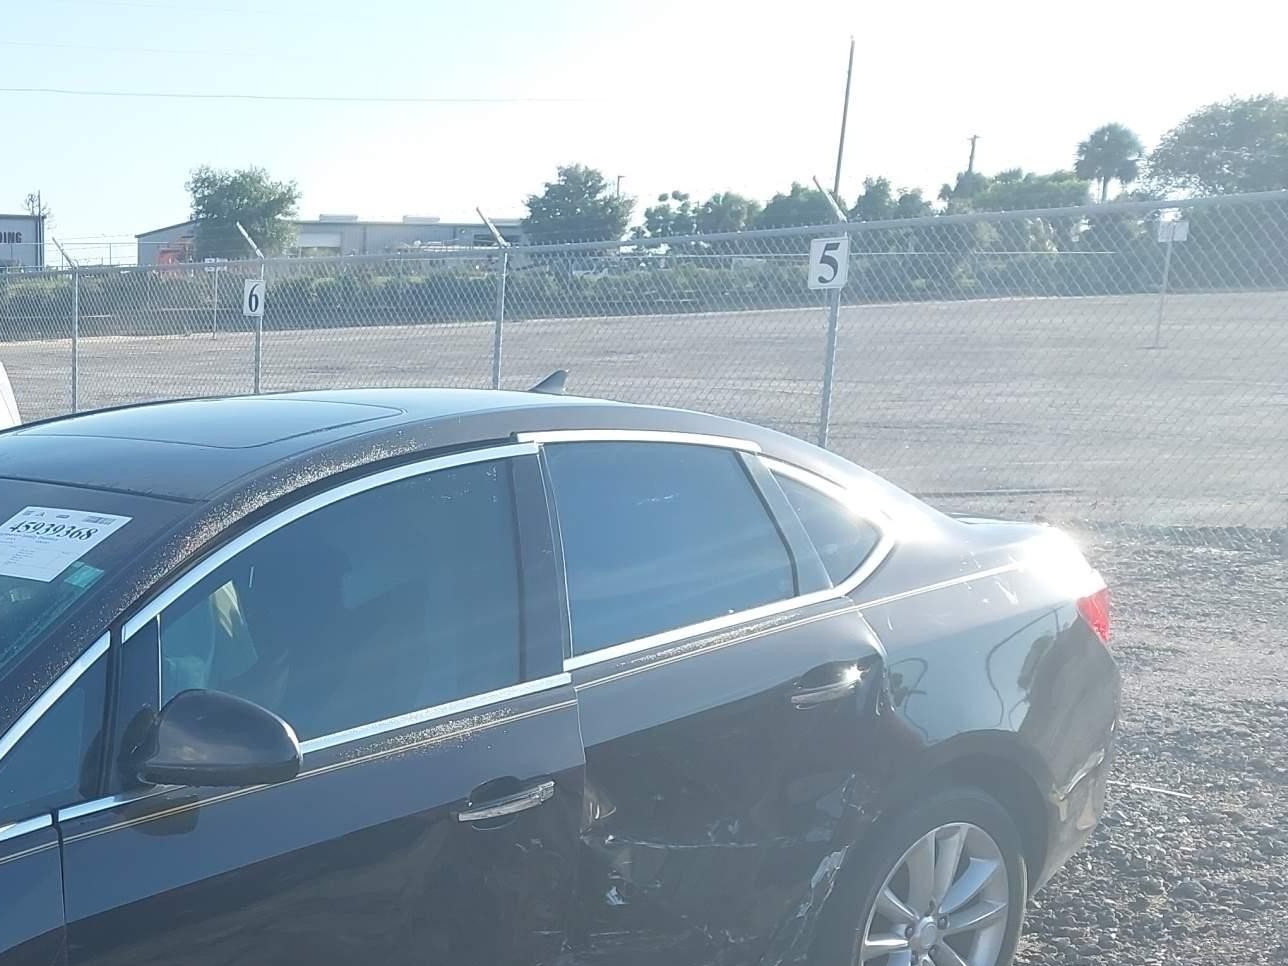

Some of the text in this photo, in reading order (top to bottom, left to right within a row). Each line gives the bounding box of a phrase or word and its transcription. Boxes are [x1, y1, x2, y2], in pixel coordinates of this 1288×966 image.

[817, 242, 841, 284] 5
[248, 283, 260, 313] 6
[9, 520, 98, 541] 45939368
